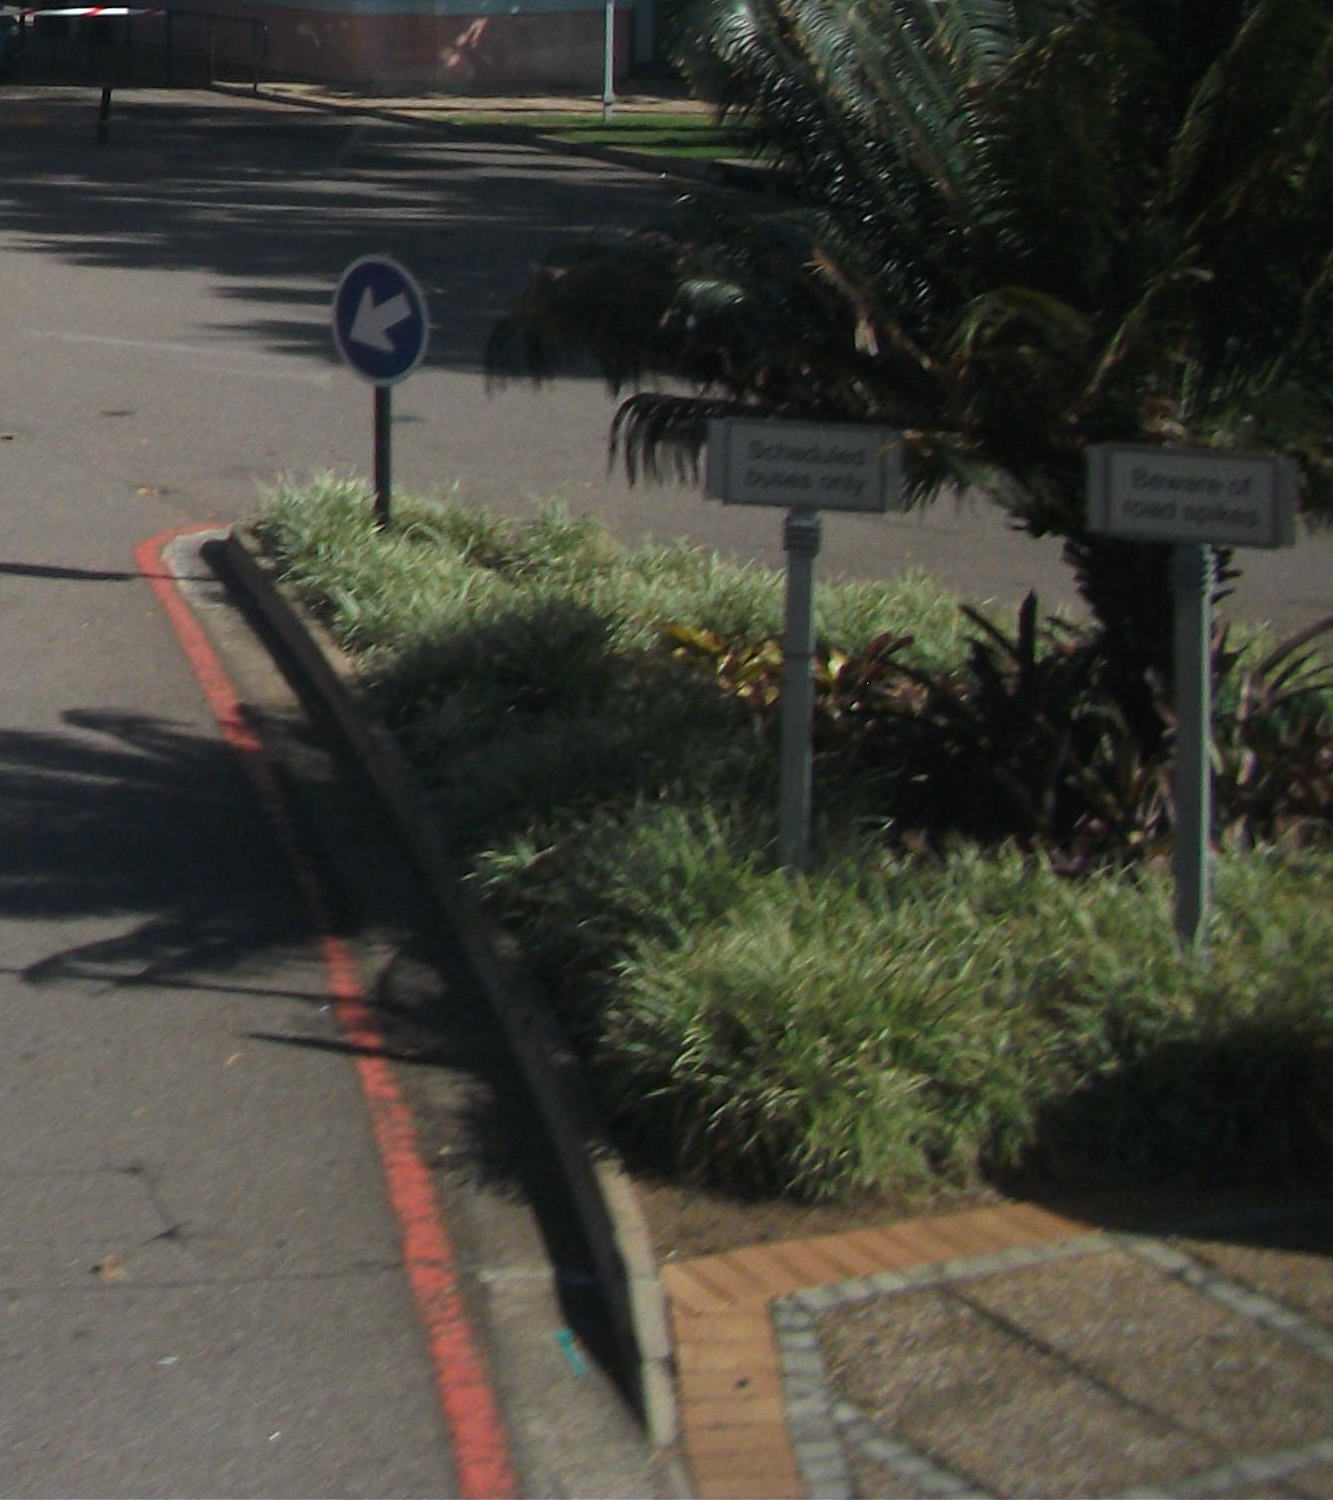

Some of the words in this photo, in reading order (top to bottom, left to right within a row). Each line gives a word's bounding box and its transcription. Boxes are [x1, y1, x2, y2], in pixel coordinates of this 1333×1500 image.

[747, 439, 868, 466] Scheduled
[819, 474, 867, 496] only
[1131, 466, 1223, 495] Beware
[1228, 475, 1253, 496] of
